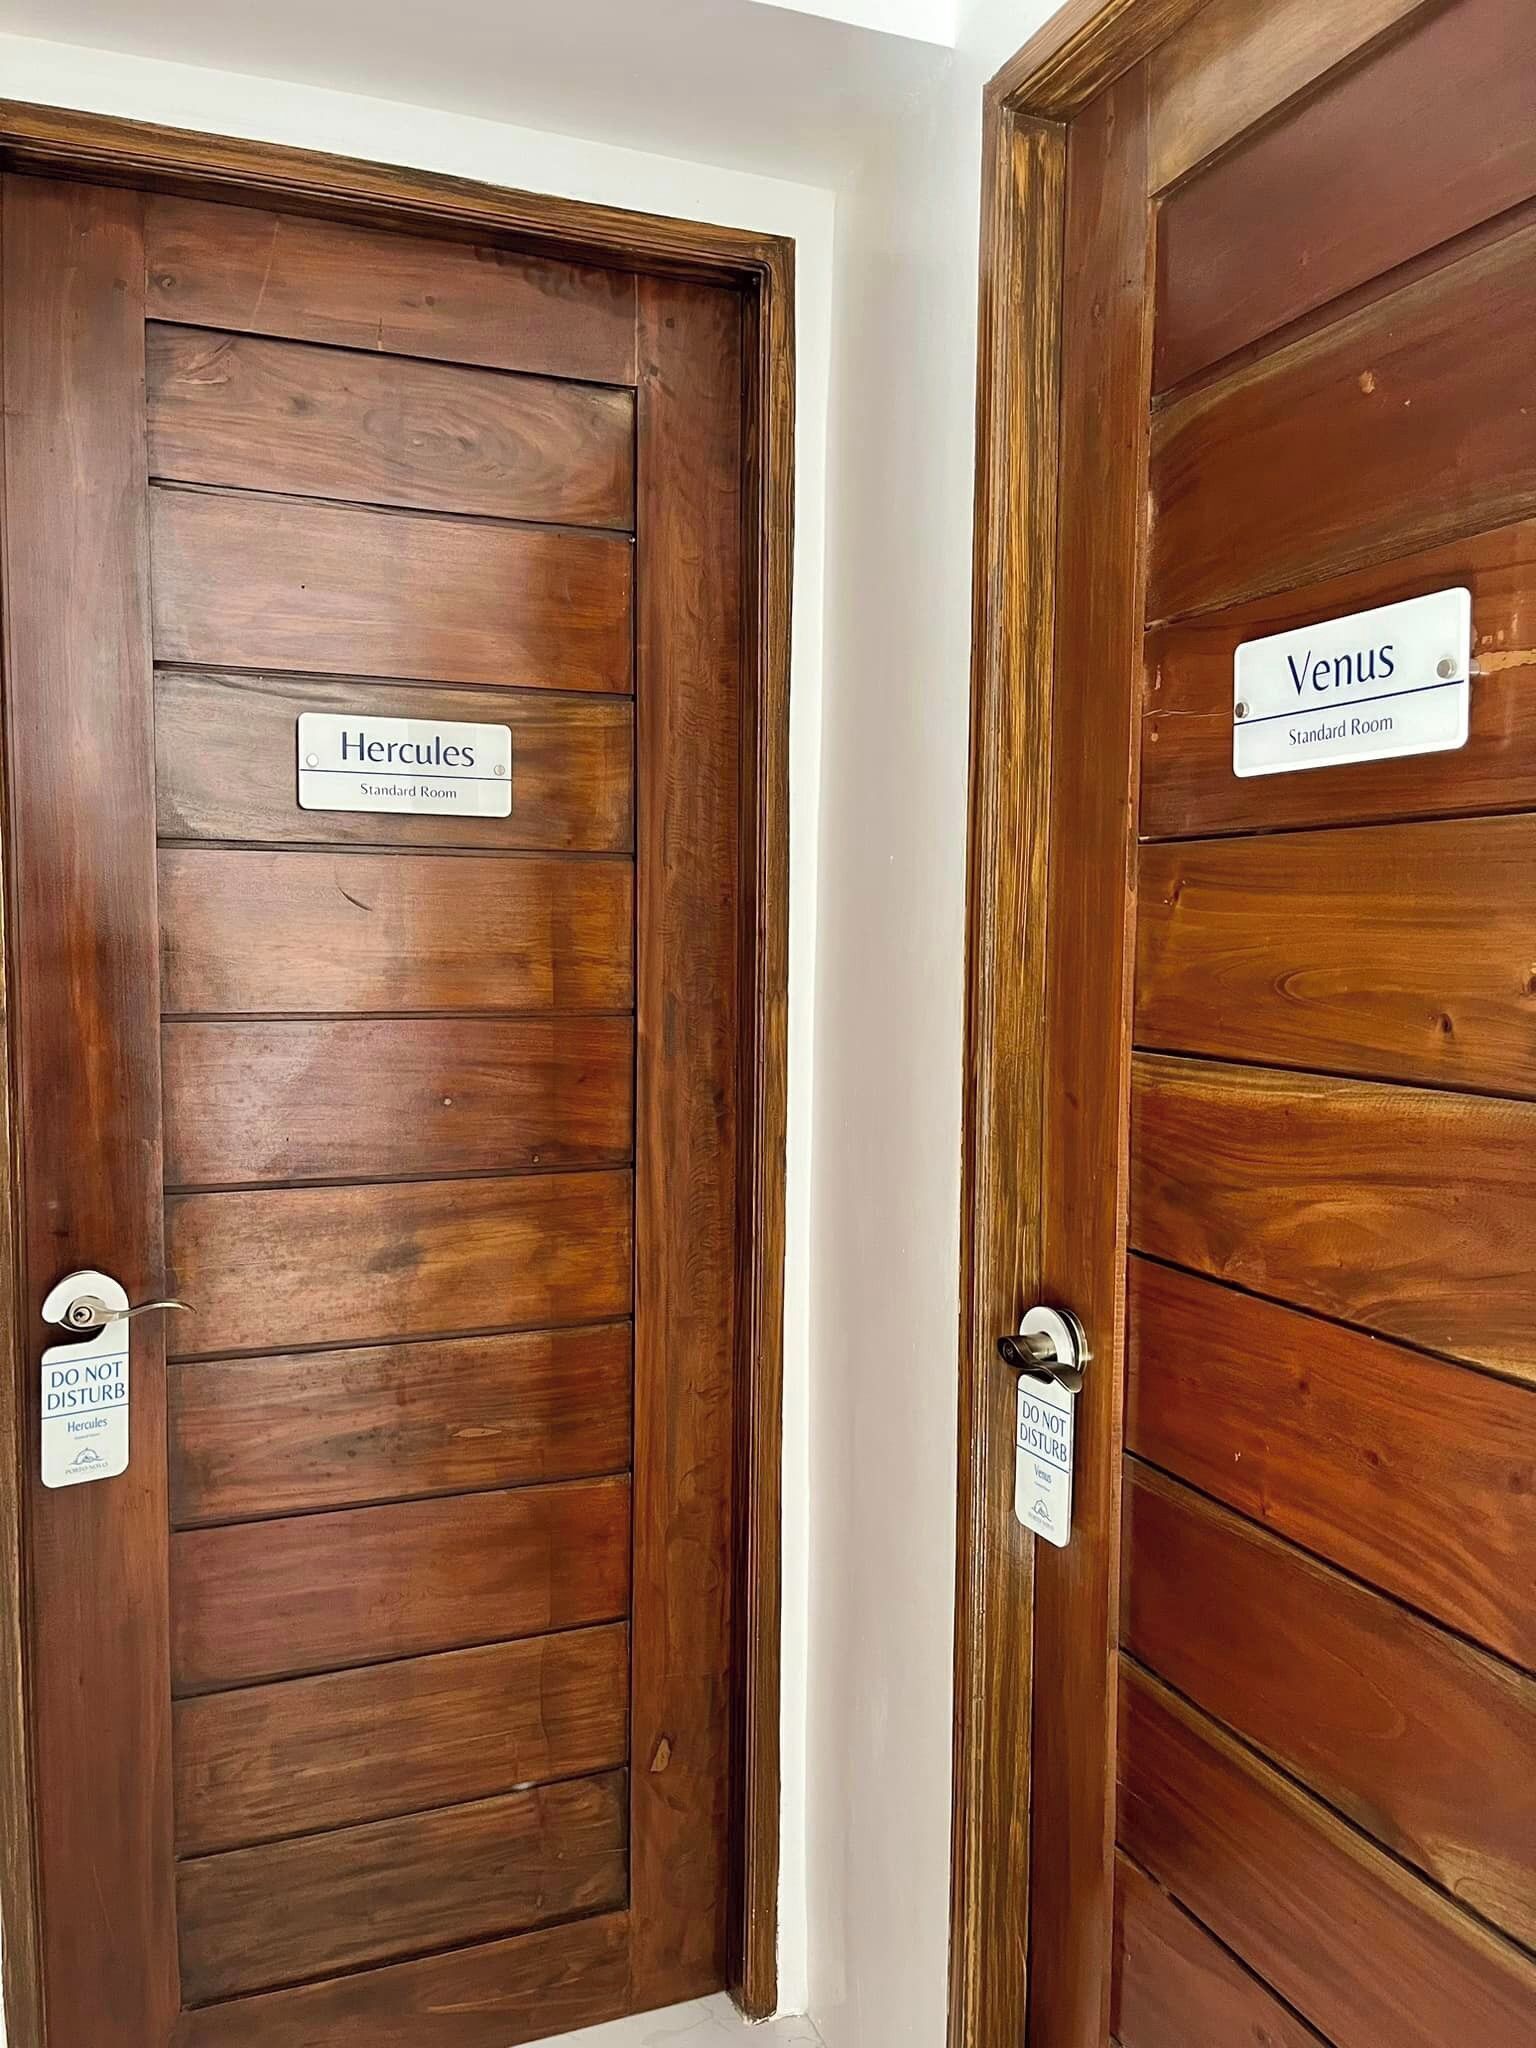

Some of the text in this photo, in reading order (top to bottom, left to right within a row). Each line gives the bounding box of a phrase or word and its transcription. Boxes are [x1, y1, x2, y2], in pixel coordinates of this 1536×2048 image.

[1287, 644, 1395, 696] Venus
[1288, 716, 1393, 745] Standard Room
[340, 731, 475, 767] Hercules
[360, 782, 457, 799] Standard Room
[51, 1361, 123, 1388] DO NOT
[47, 1382, 125, 1411] DISTURB
[67, 1417, 108, 1433] Hercules
[1022, 1400, 1067, 1438] DO NOT
[1019, 1422, 1068, 1463] DISTURB
[1034, 1463, 1052, 1484] Venus
